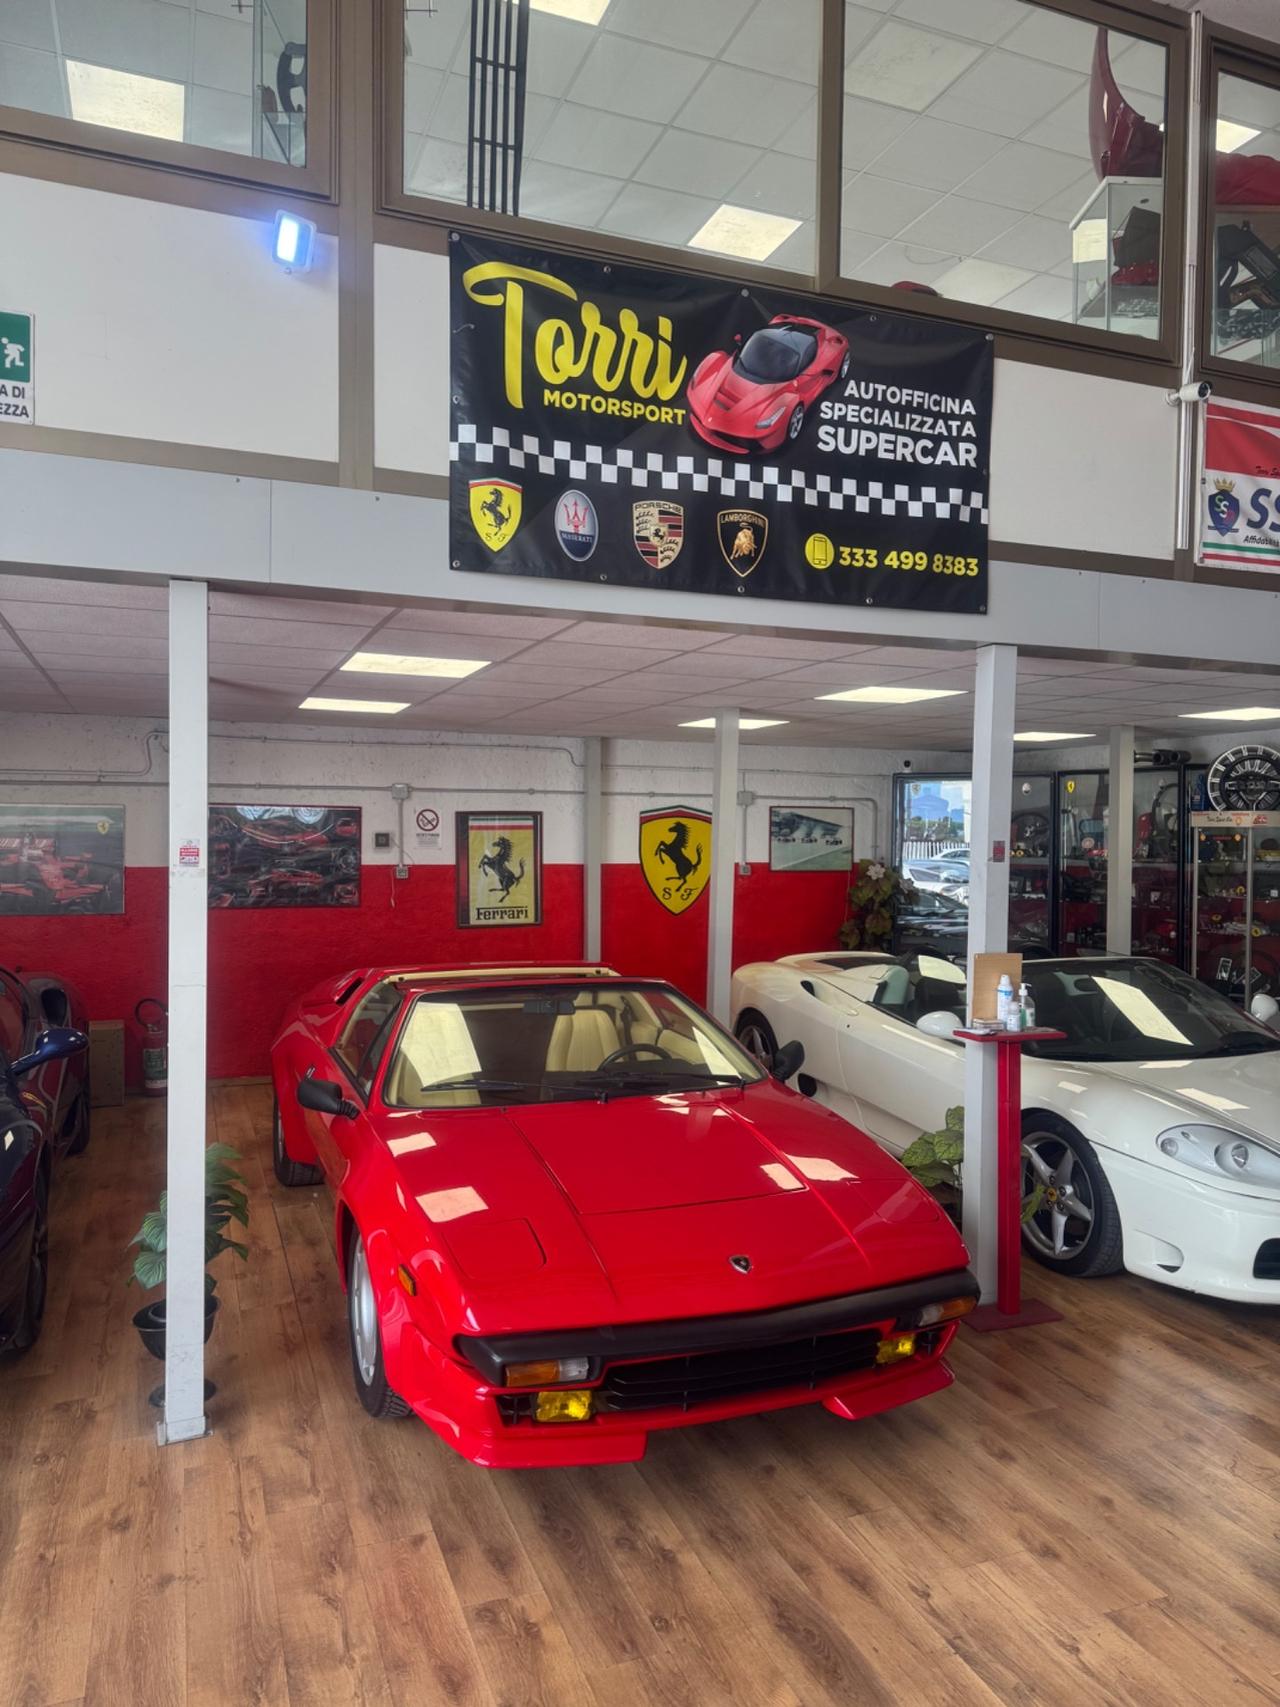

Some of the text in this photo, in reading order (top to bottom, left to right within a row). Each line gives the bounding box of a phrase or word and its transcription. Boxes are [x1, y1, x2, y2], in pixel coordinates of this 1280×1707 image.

[463, 261, 688, 409] Torri
[12, 386, 25, 399] DI
[543, 388, 686, 425] MOTORSPORT
[844, 379, 977, 415] AUTOFFICINA
[819, 400, 977, 438] SPECIALIZZATA
[817, 424, 977, 468] SUPERCAR
[634, 502, 682, 513] PORSCHE
[839, 546, 979, 576] 333 499 8383
[662, 887, 672, 900] S
[475, 906, 529, 920] Ferrari
